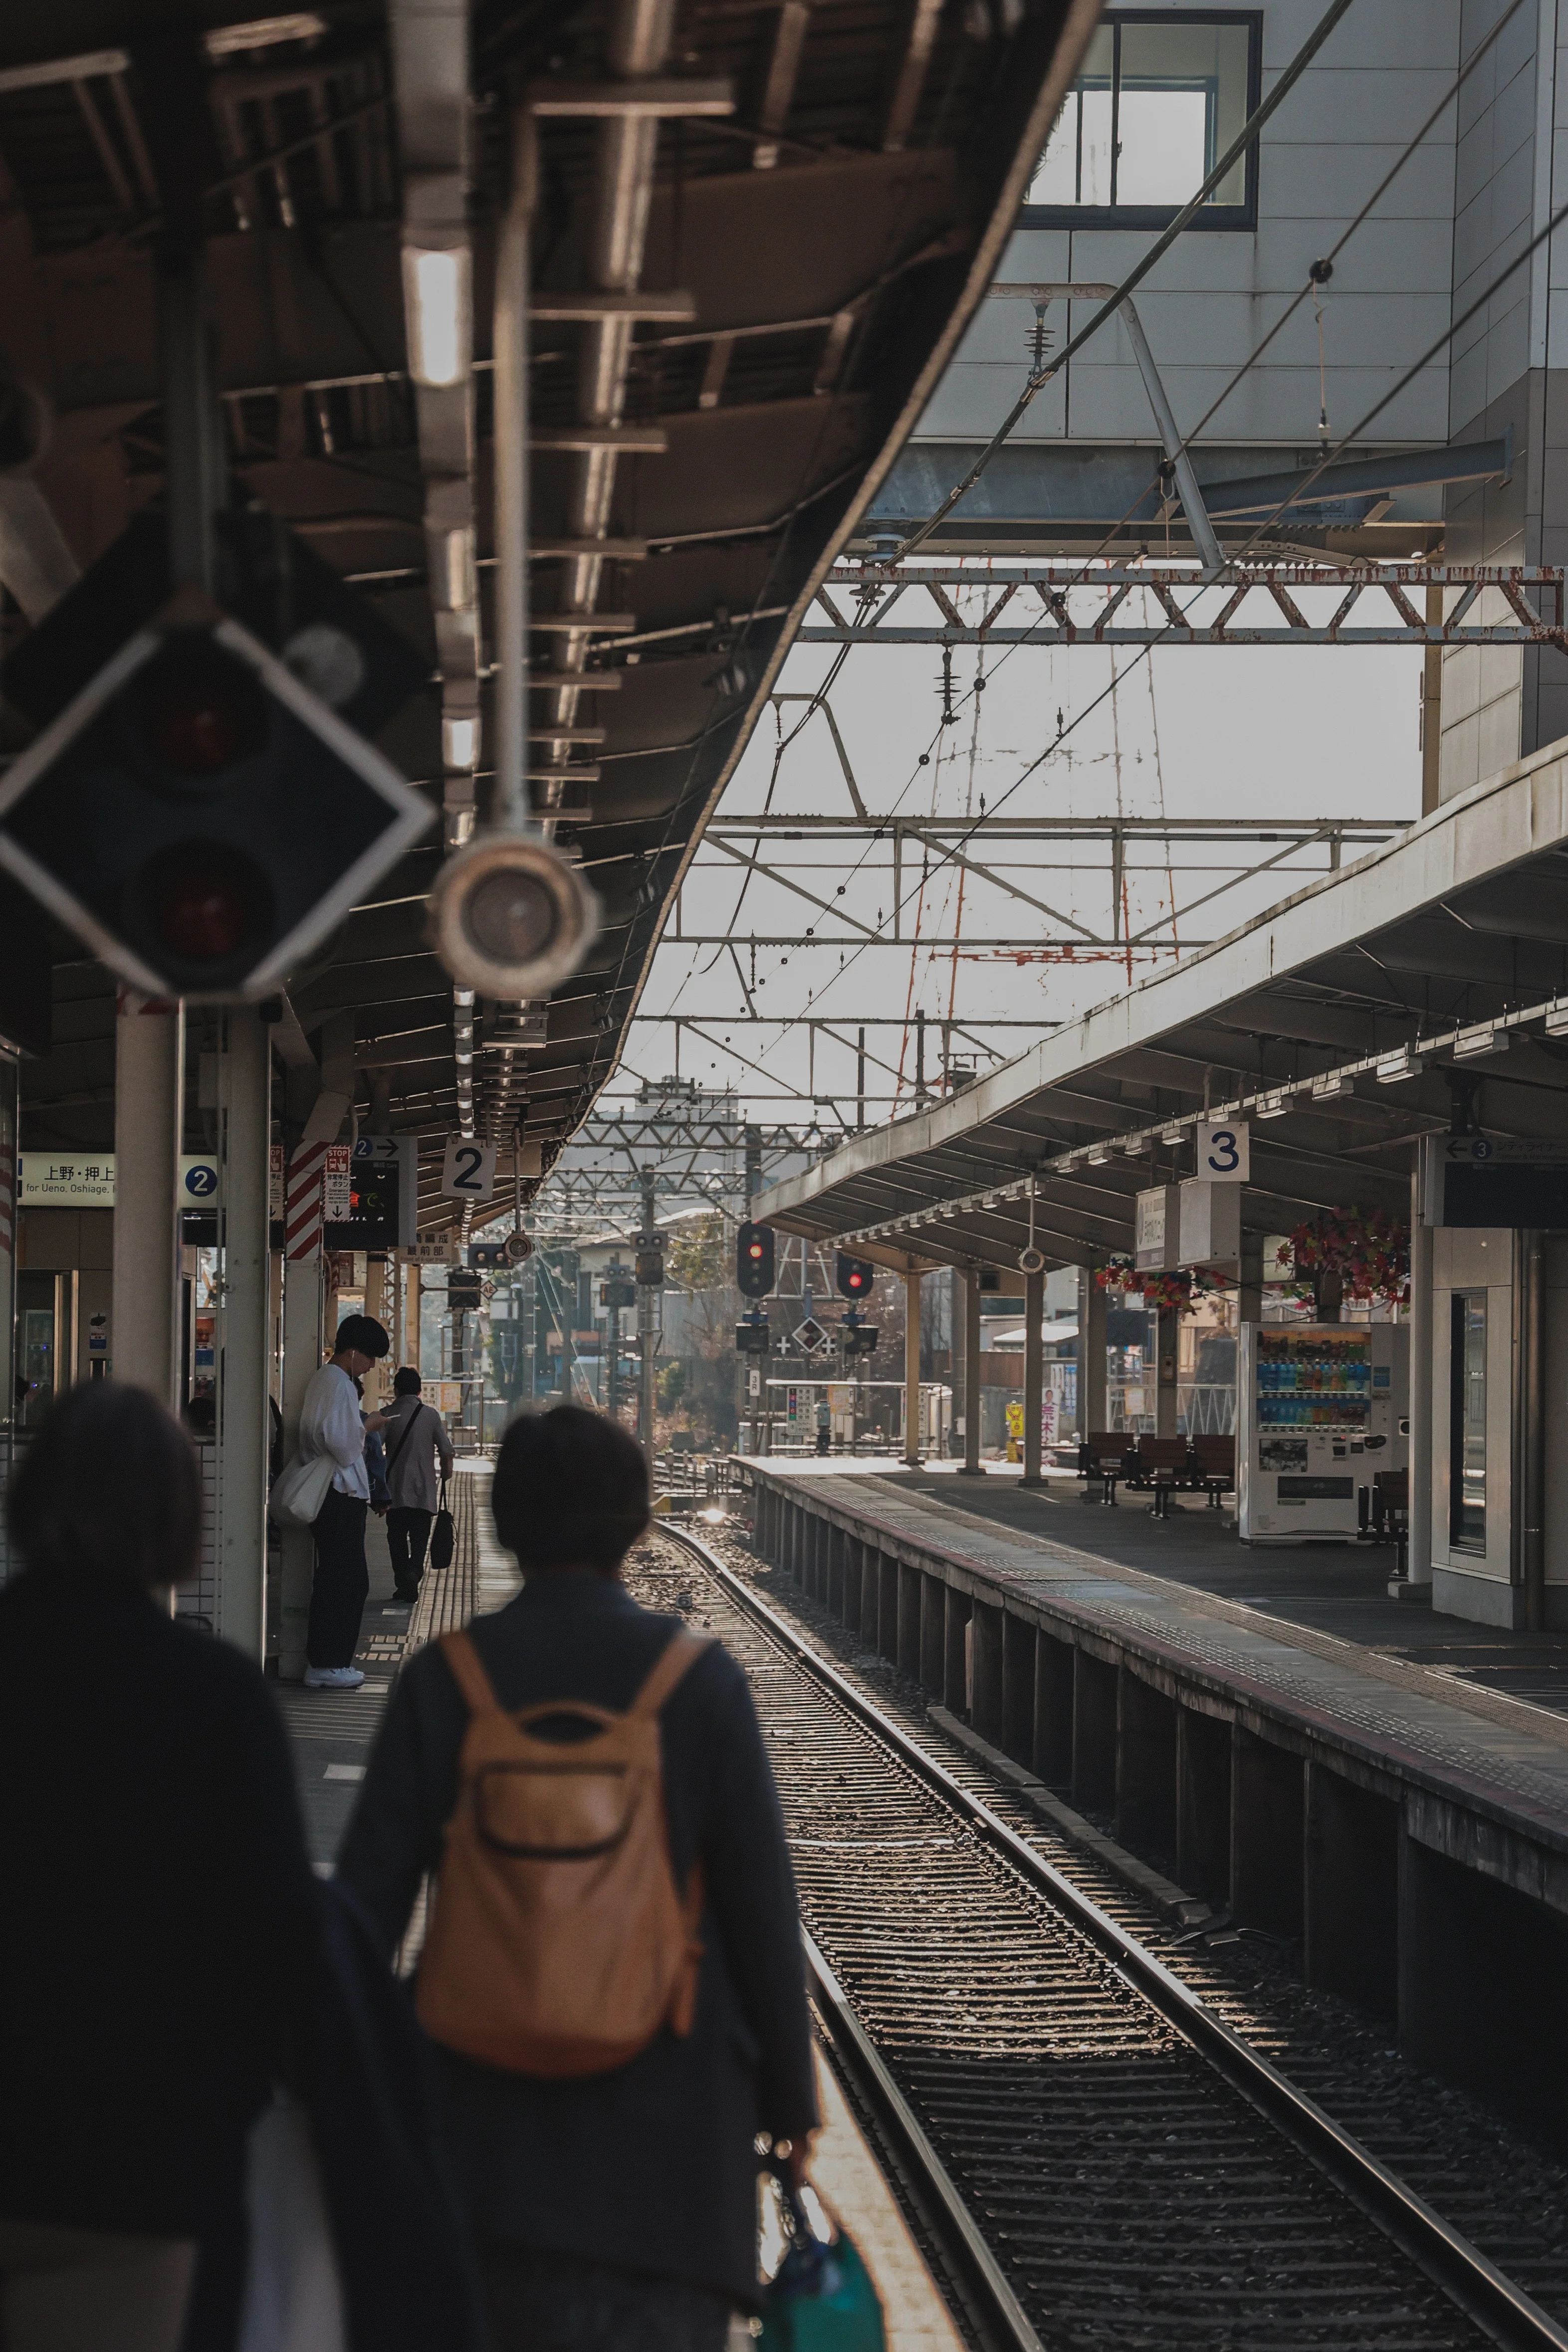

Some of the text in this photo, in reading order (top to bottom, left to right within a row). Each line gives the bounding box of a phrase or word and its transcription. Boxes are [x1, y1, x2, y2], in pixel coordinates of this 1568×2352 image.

[358, 1140, 367, 1155] 2
[1208, 1131, 1239, 1172] 3
[1478, 1142, 1486, 1157] 3
[44, 1165, 114, 1181] 上野・押上
[453, 1147, 482, 1190] 2
[194, 1171, 208, 1192] 2
[678, 1596, 689, 1606] 6
